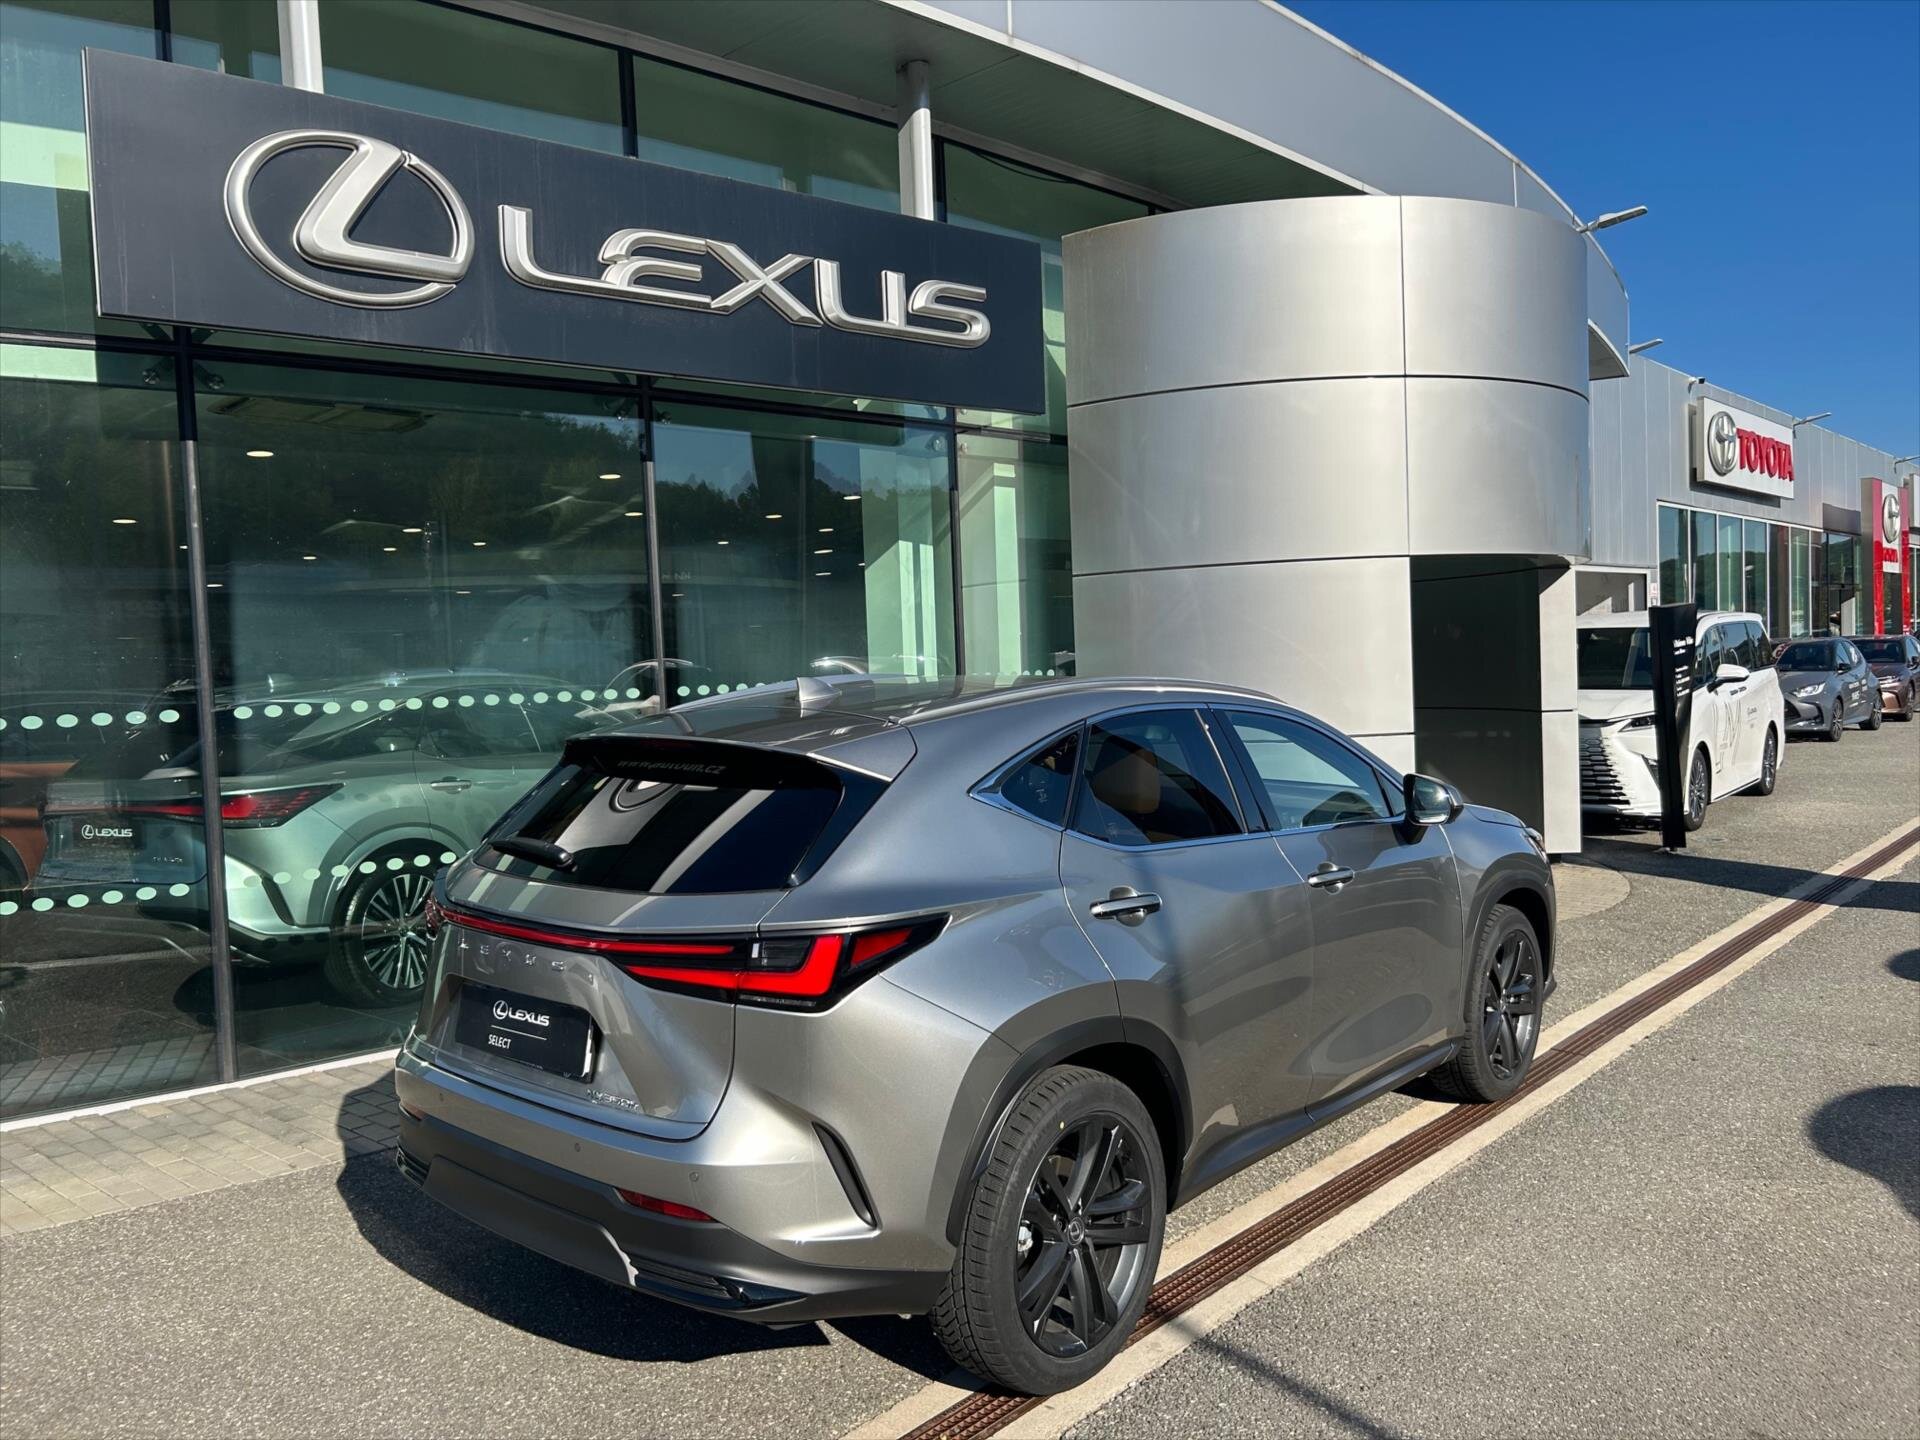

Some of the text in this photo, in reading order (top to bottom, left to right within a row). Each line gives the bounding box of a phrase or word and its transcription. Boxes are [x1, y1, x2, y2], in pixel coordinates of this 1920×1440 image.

[497, 203, 992, 350] LEXUS
[1736, 428, 1795, 481] TOYOTA
[95, 828, 133, 838] LEXUS
[508, 1007, 550, 1027] LEXUS
[488, 1034, 511, 1049] SELECT
